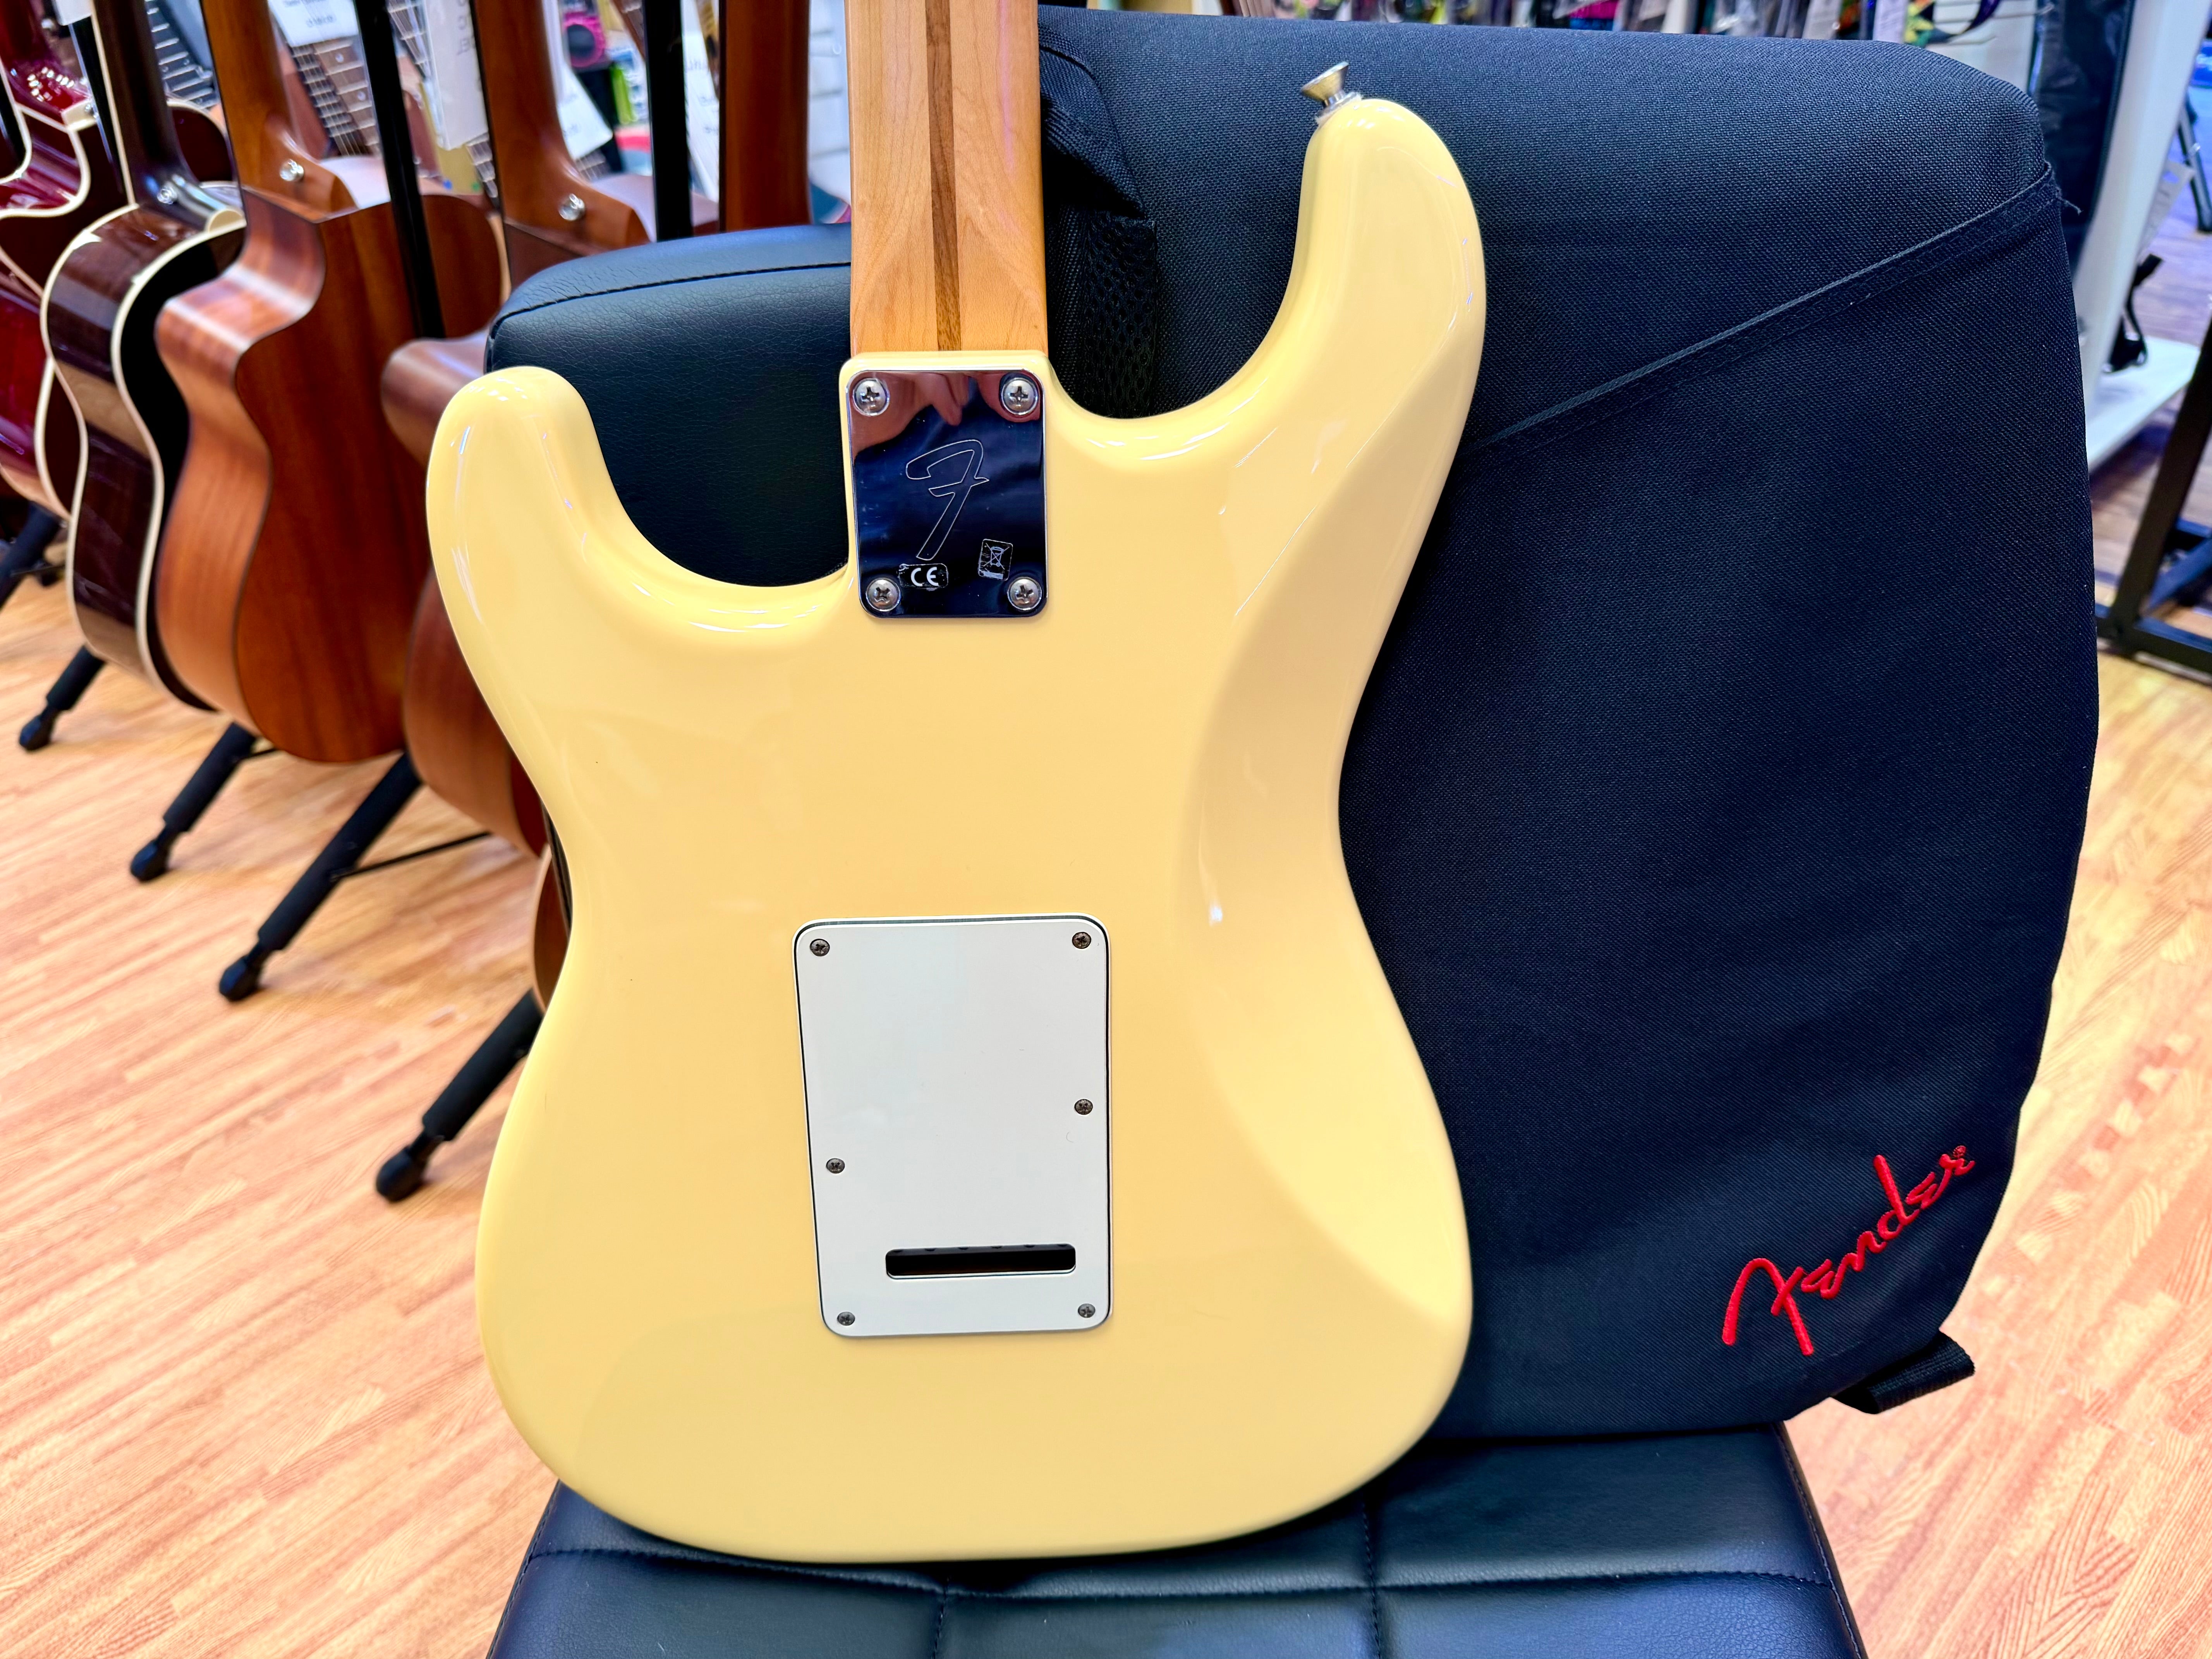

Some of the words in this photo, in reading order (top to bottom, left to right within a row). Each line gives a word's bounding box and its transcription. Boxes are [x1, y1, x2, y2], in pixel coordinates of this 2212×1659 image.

[905, 439, 989, 561] F
[910, 566, 939, 587] CE
[1722, 1154, 1975, 1356] Fender
